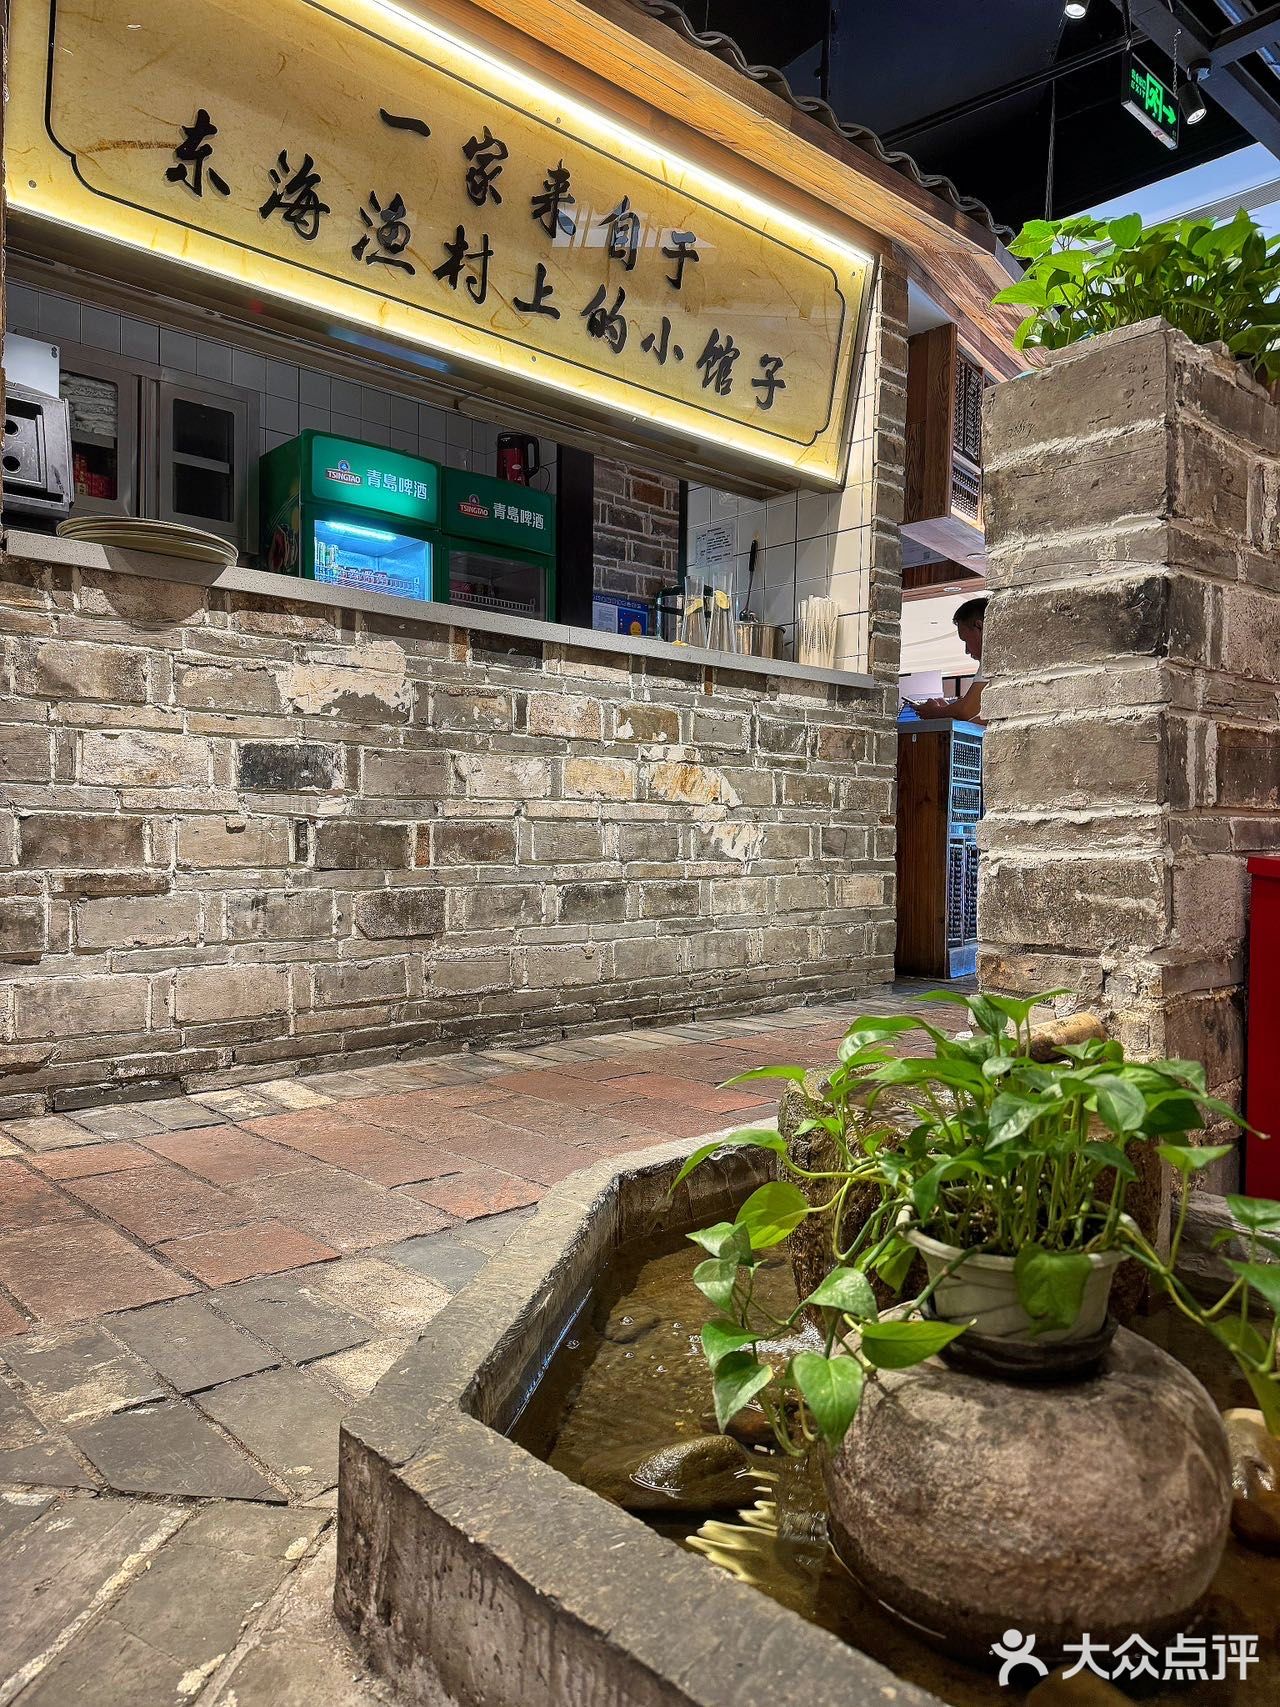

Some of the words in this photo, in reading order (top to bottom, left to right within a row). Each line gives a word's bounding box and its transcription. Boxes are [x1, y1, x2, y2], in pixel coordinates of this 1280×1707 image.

[1130, 80, 1146, 99] EXIT
[379, 108, 700, 290] 一家来自于
[165, 109, 787, 410] 东海渔村上的小馆子
[327, 470, 361, 484] TSINGTAO
[459, 504, 489, 516] TSINGTAO
